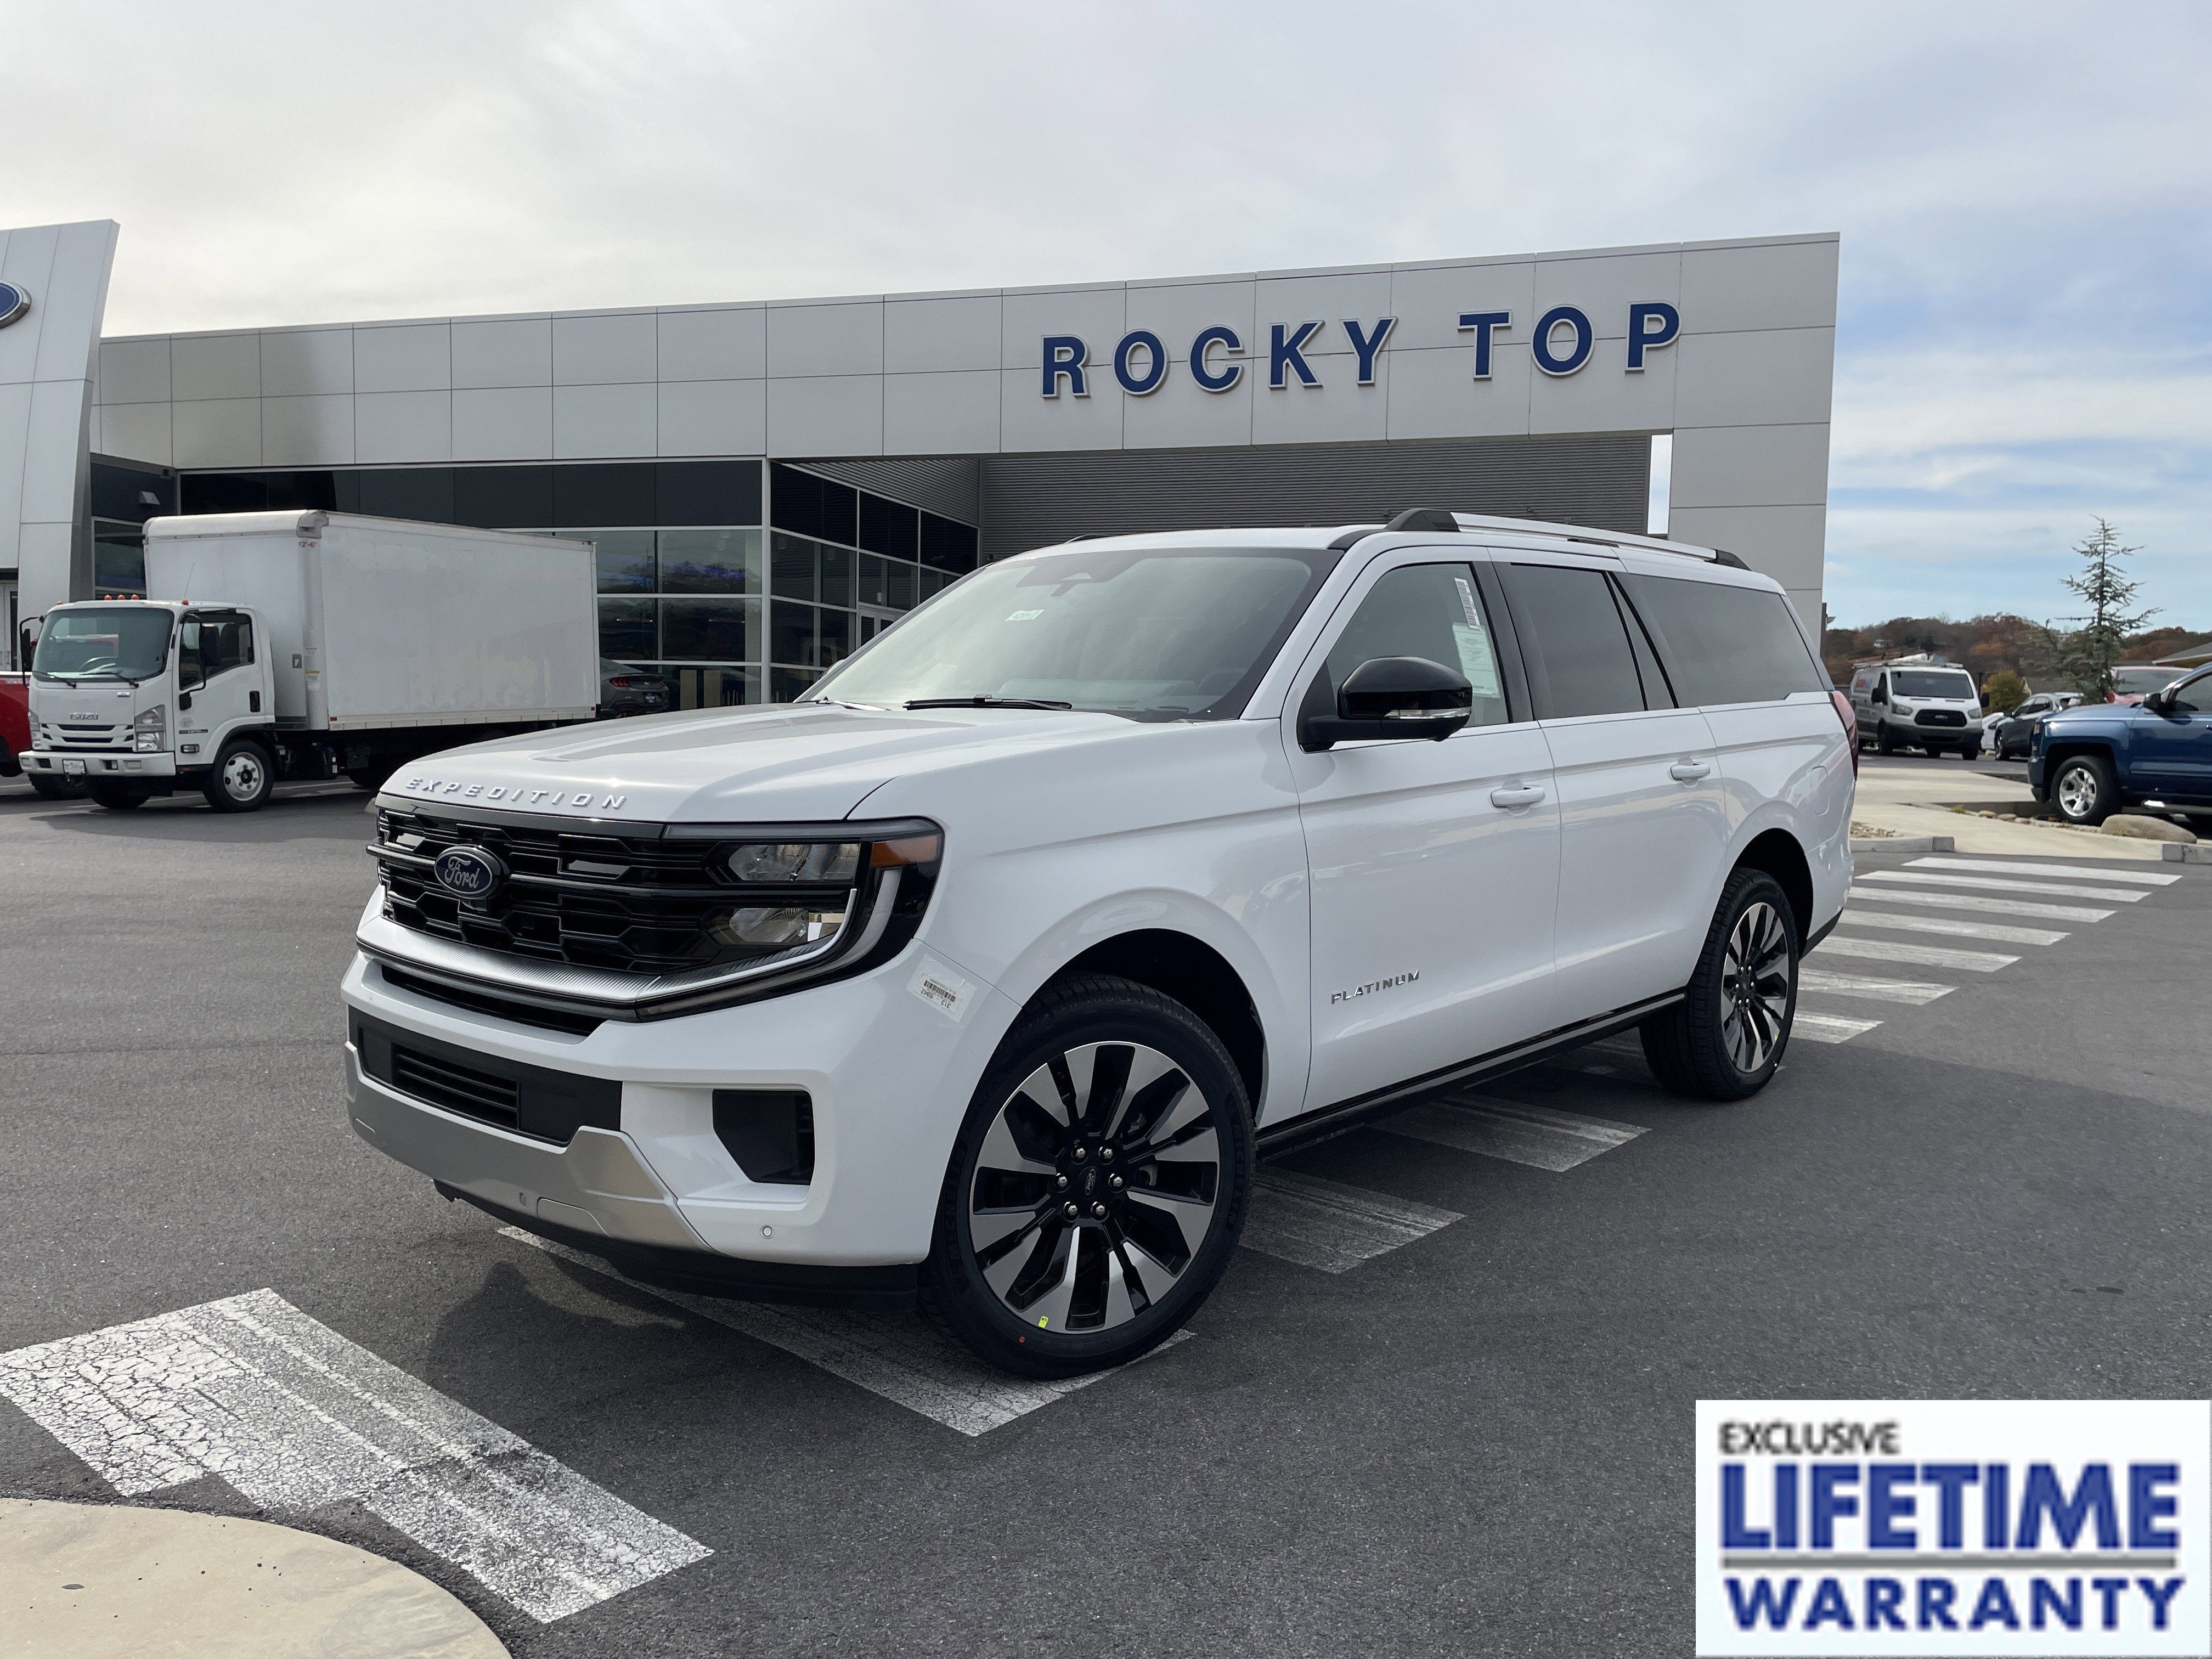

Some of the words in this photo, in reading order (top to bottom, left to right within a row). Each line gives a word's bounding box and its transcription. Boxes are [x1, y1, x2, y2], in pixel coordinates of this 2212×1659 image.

[1041, 317, 1397, 397] ROCKY
[1457, 300, 1681, 381] TOP
[405, 777, 627, 809] EXPEDITION
[444, 856, 481, 889] Ford
[921, 989, 934, 1000] 5942
[1331, 970, 1419, 1005] PLATINUM
[941, 1000, 951, 1009] 313
[1086, 1173, 1094, 1190] Ford
